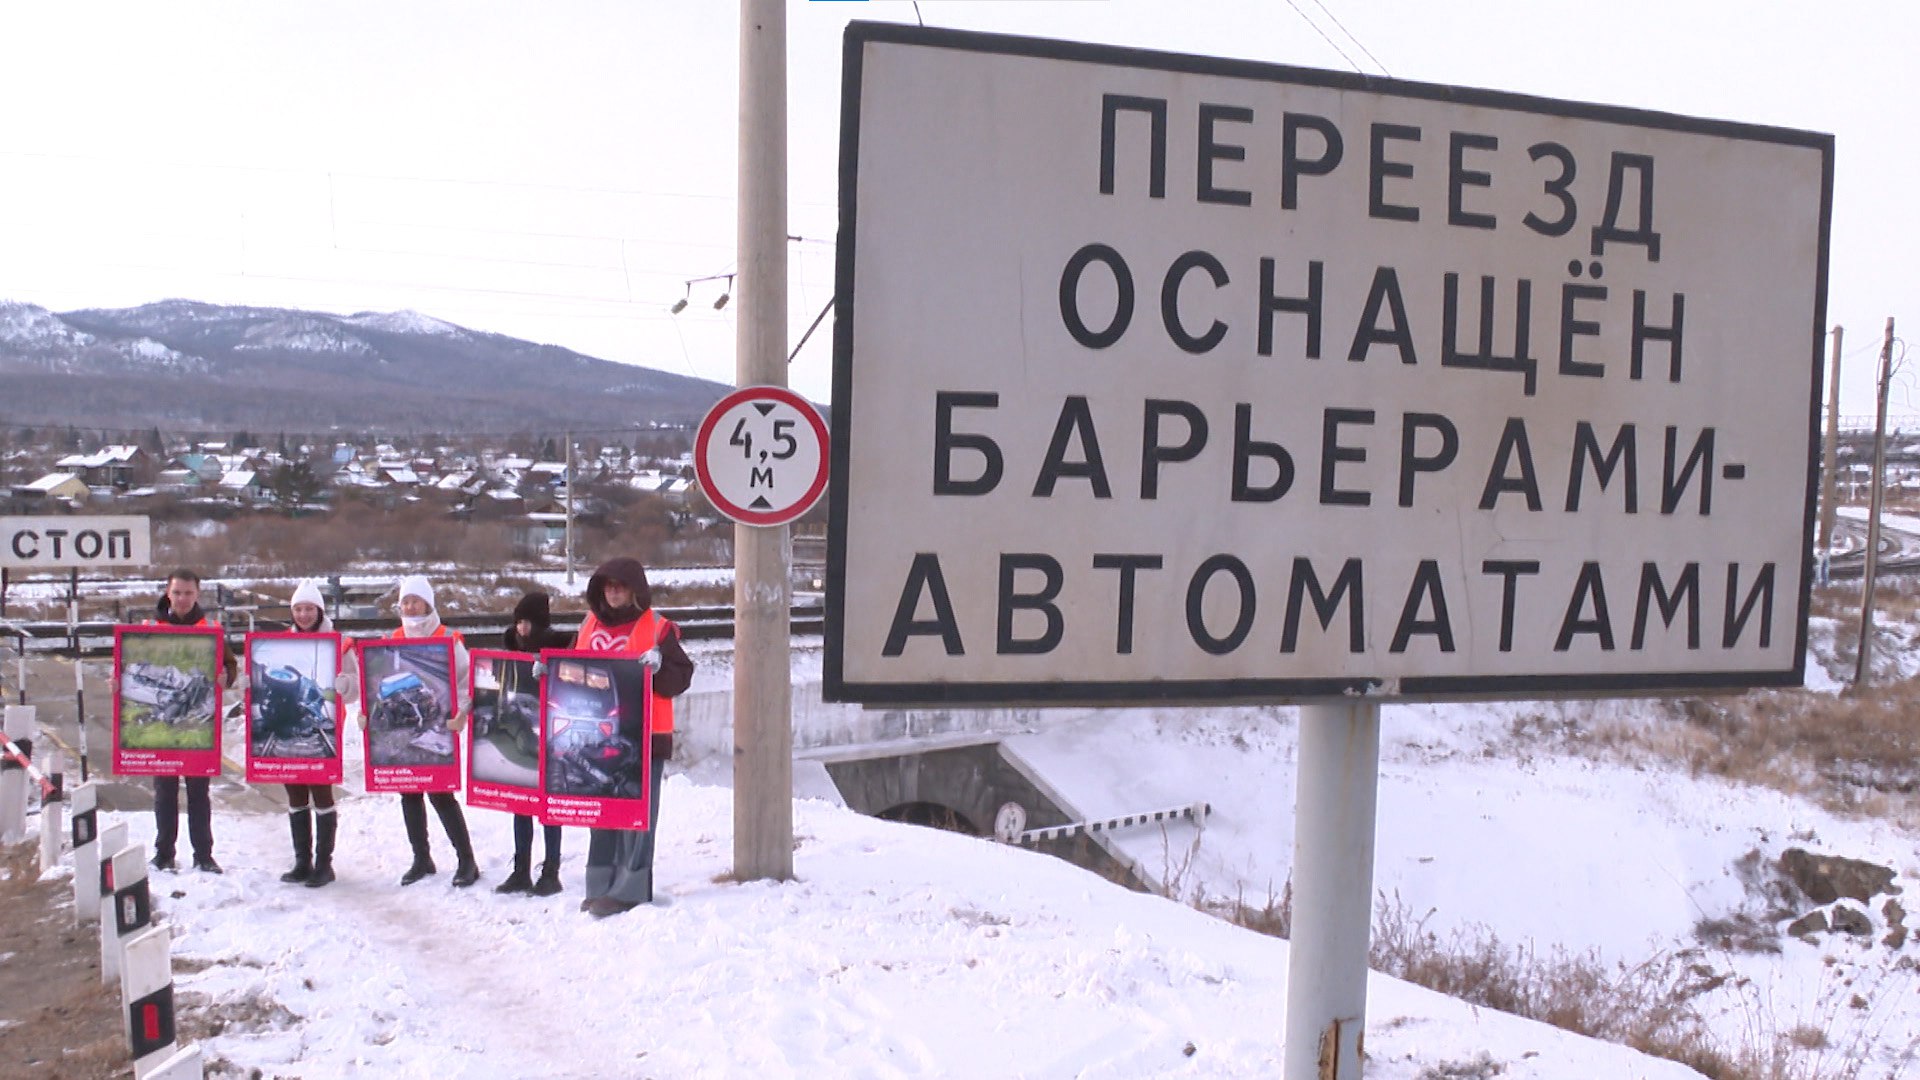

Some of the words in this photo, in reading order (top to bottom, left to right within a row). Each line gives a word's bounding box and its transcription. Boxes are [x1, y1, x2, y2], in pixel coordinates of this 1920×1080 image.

[1100, 93, 1662, 264] ПЕРЕЕЗД
[1059, 243, 1686, 397] ОСНАЩЁН
[729, 416, 798, 464] 4,5
[933, 390, 1746, 517] БАРЬЕРАМИ-
[12, 529, 132, 559] СТОП
[881, 551, 1777, 658] АВТОМАТАМИ
[546, 796, 602, 808] Осторожность
